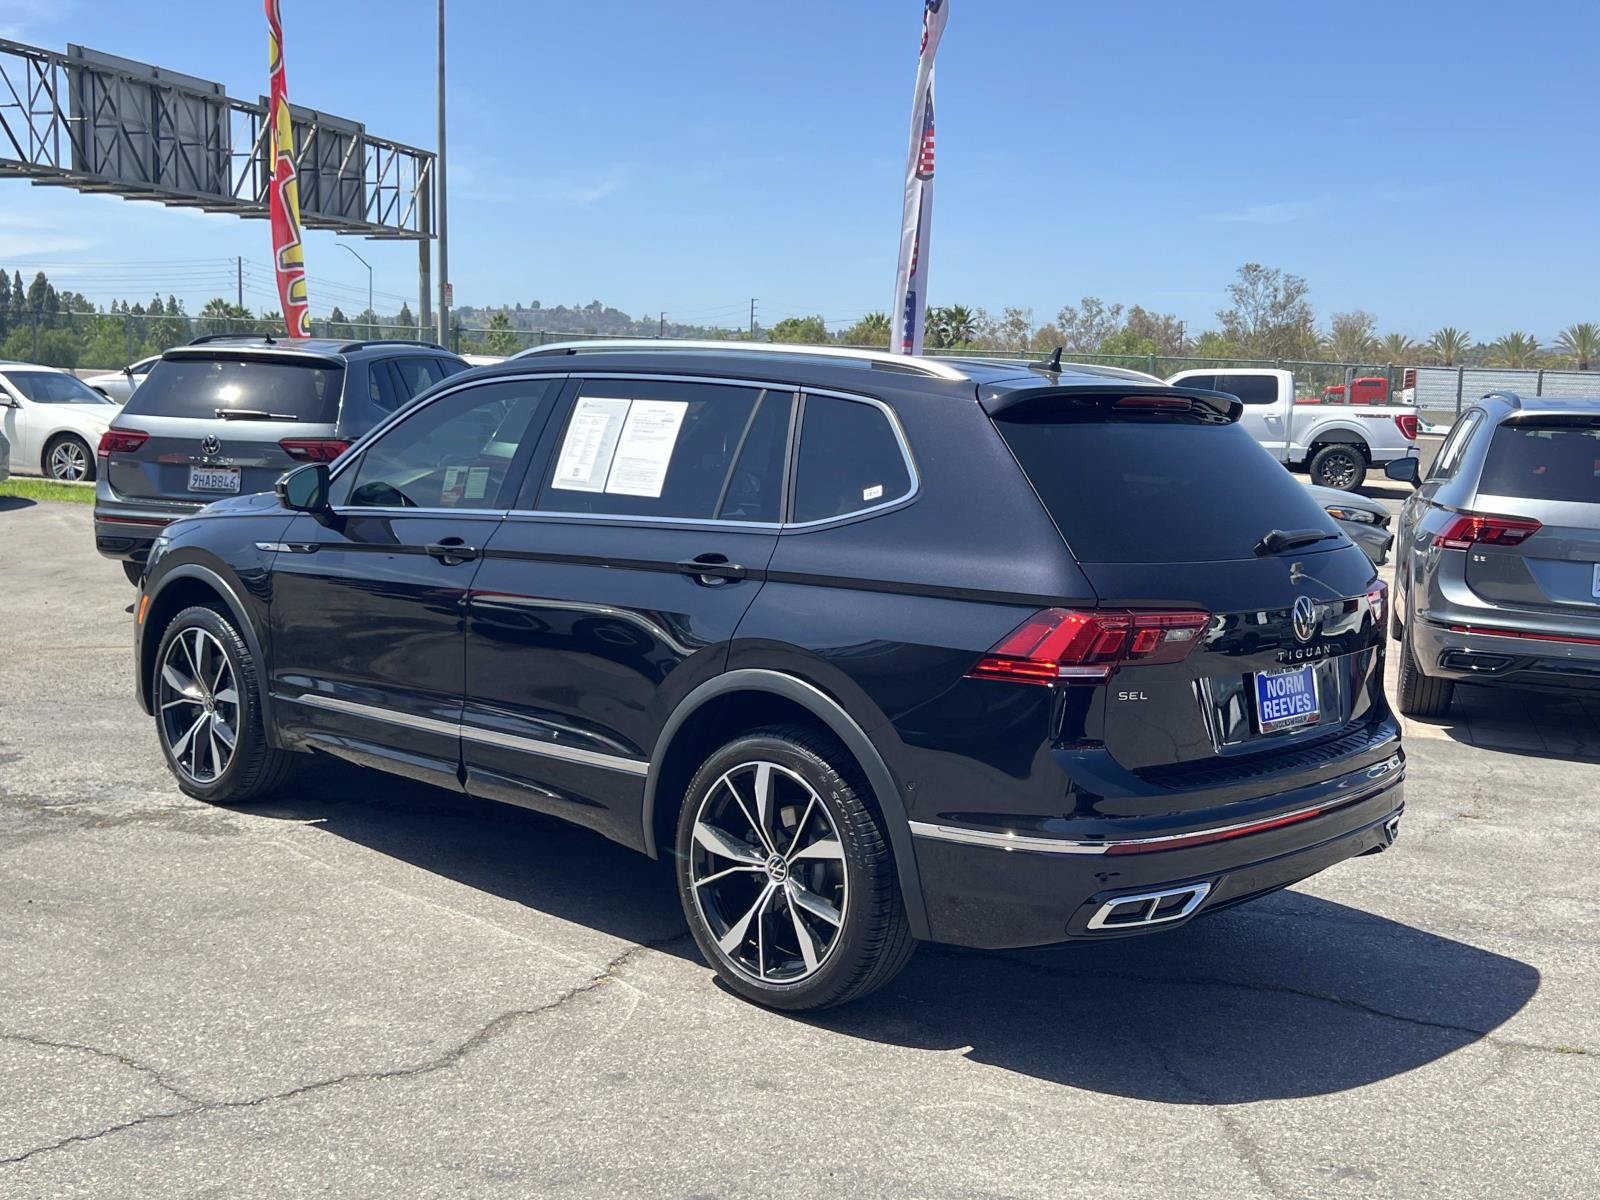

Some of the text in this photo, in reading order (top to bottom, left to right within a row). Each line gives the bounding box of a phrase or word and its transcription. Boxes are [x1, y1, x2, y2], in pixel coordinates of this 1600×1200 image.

[1278, 644, 1331, 661] TIGUAN
[1118, 691, 1148, 701] SEL
[1266, 674, 1305, 699] NORM
[1263, 692, 1312, 719] REEVES
